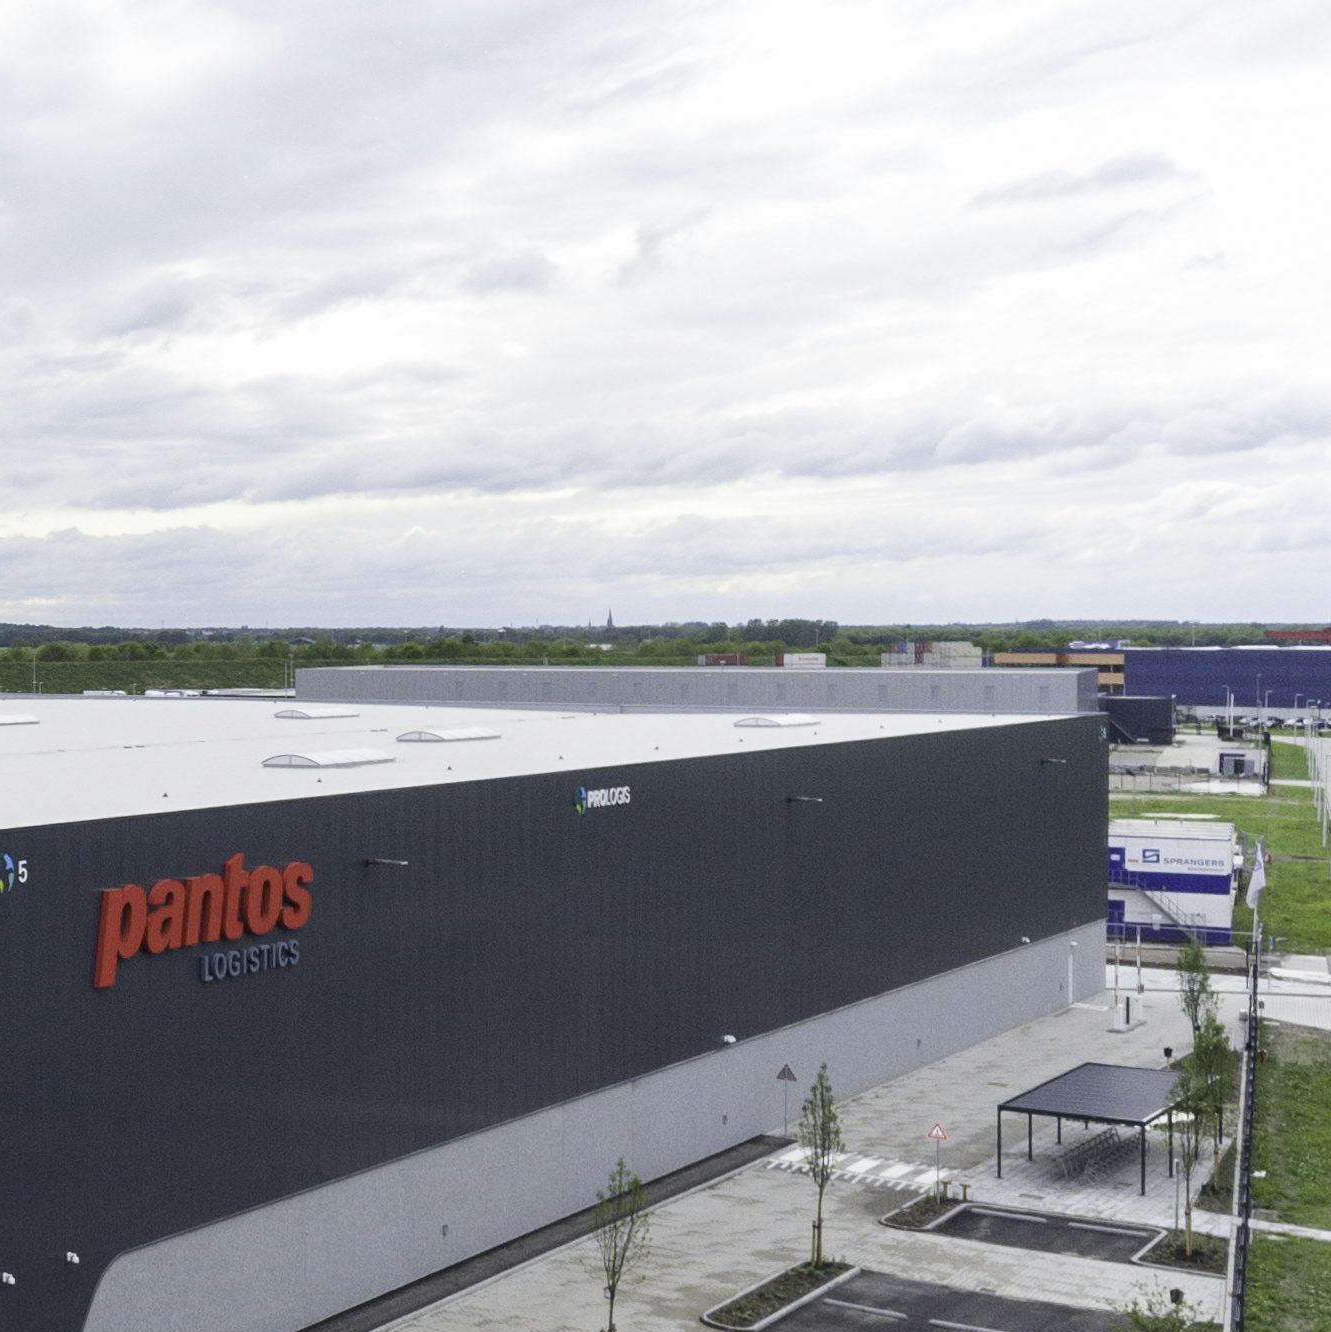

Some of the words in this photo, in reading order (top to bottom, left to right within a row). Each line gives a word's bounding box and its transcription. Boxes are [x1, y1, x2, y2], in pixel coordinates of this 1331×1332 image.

[587, 785, 631, 808] PROLOGIS
[17, 860, 28, 884] 5
[1163, 857, 1225, 867] SPRANGERS
[93, 852, 314, 989] pantos
[200, 939, 300, 983] LOGISTICS
